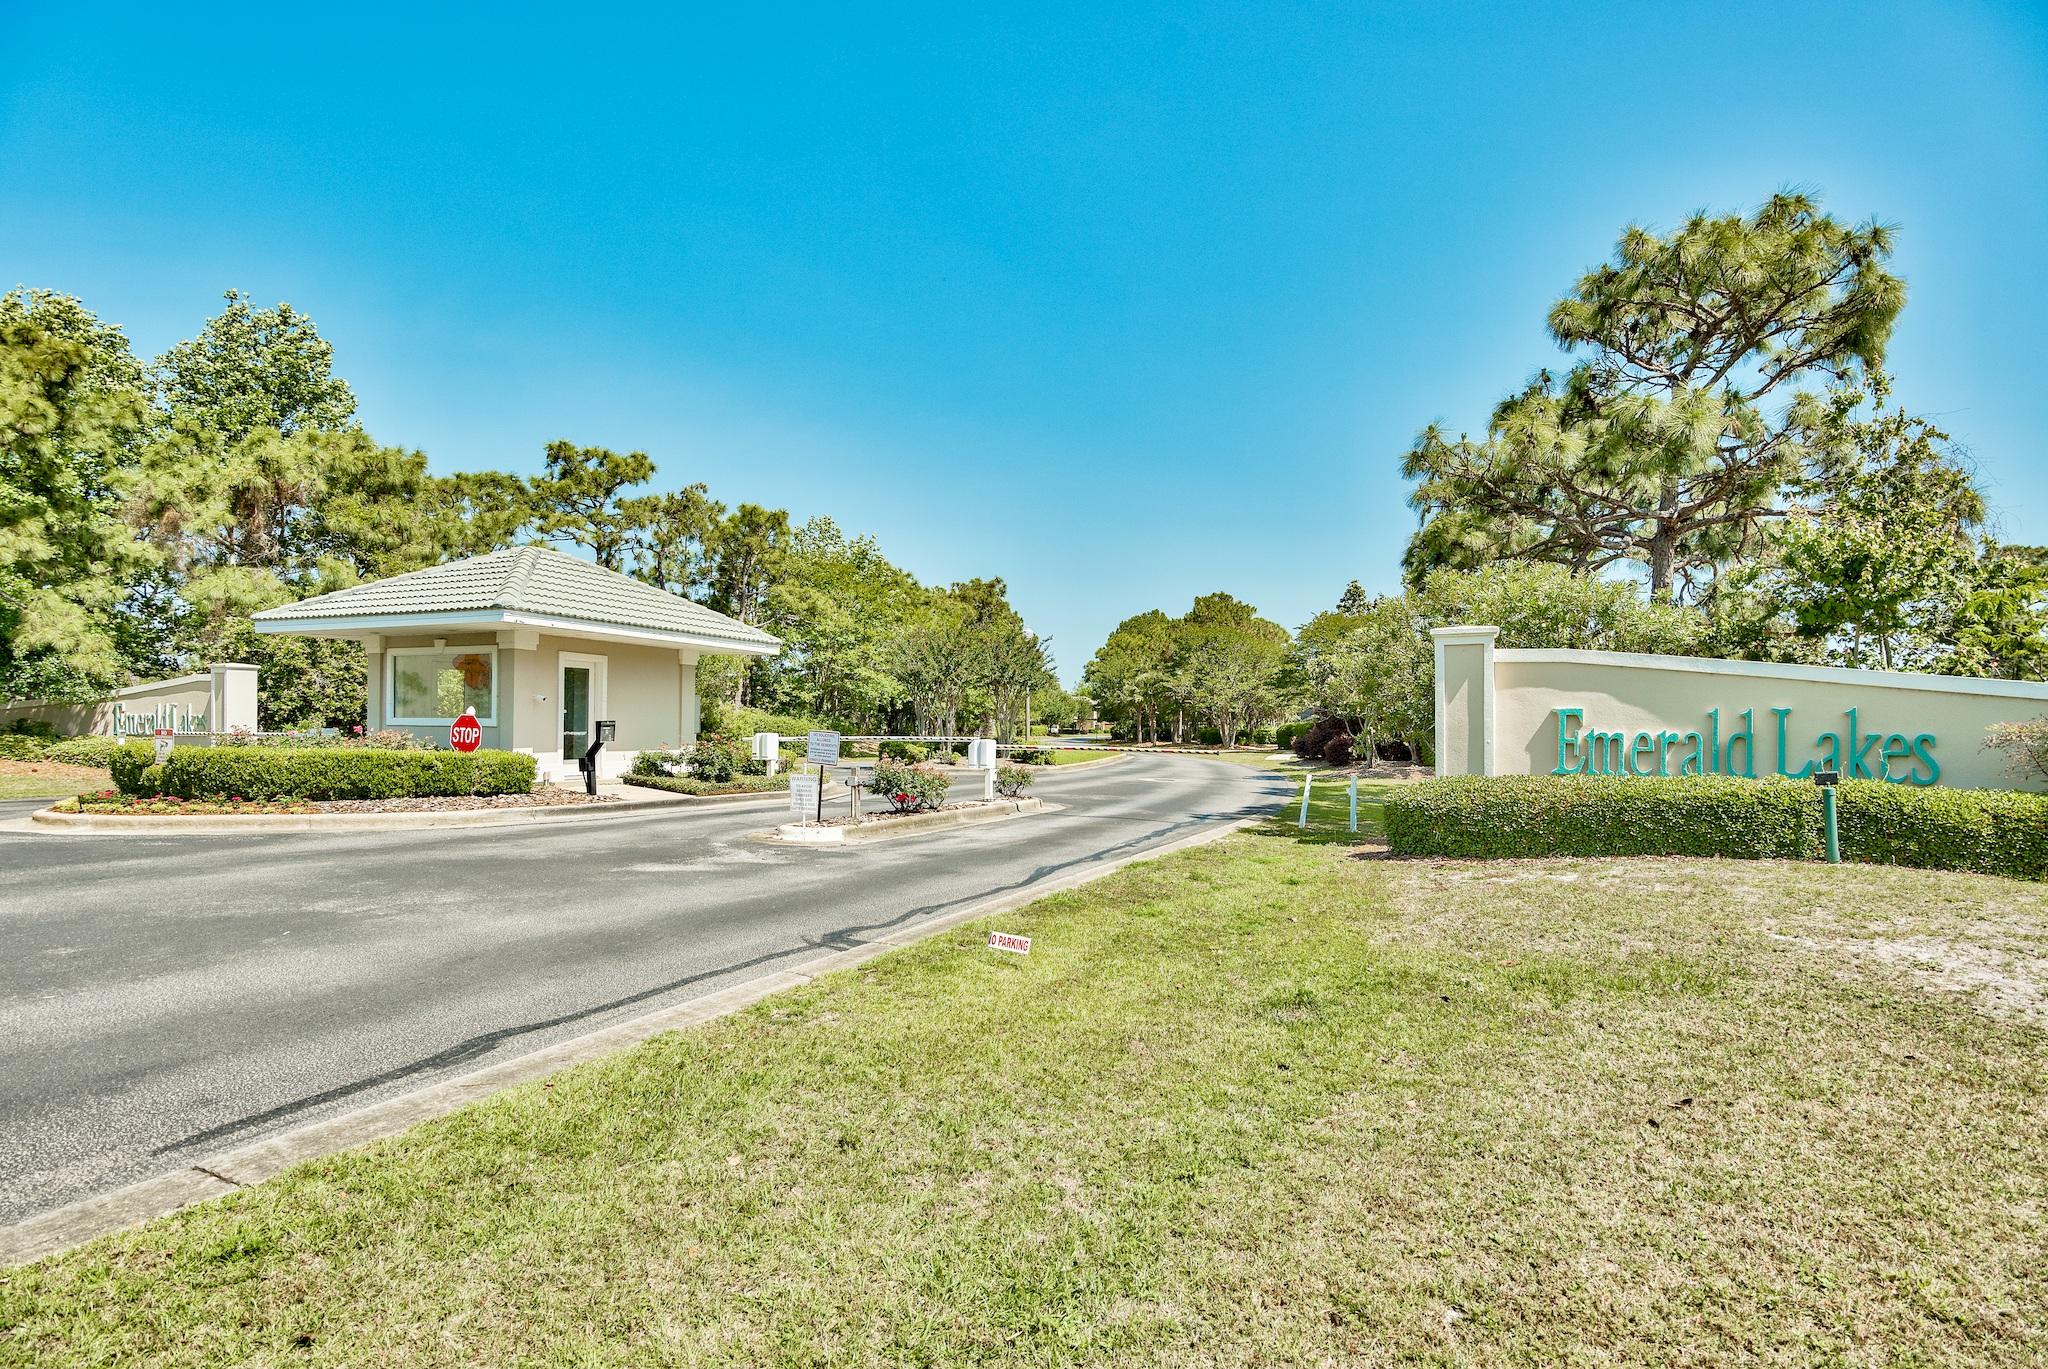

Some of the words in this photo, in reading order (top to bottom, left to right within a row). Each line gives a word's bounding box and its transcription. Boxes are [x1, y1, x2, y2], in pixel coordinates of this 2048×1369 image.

[452, 727, 480, 743] STOP
[1551, 706, 1757, 779] Emerald
[1770, 706, 1942, 786] Lakes
[998, 935, 1029, 951] PARKING
